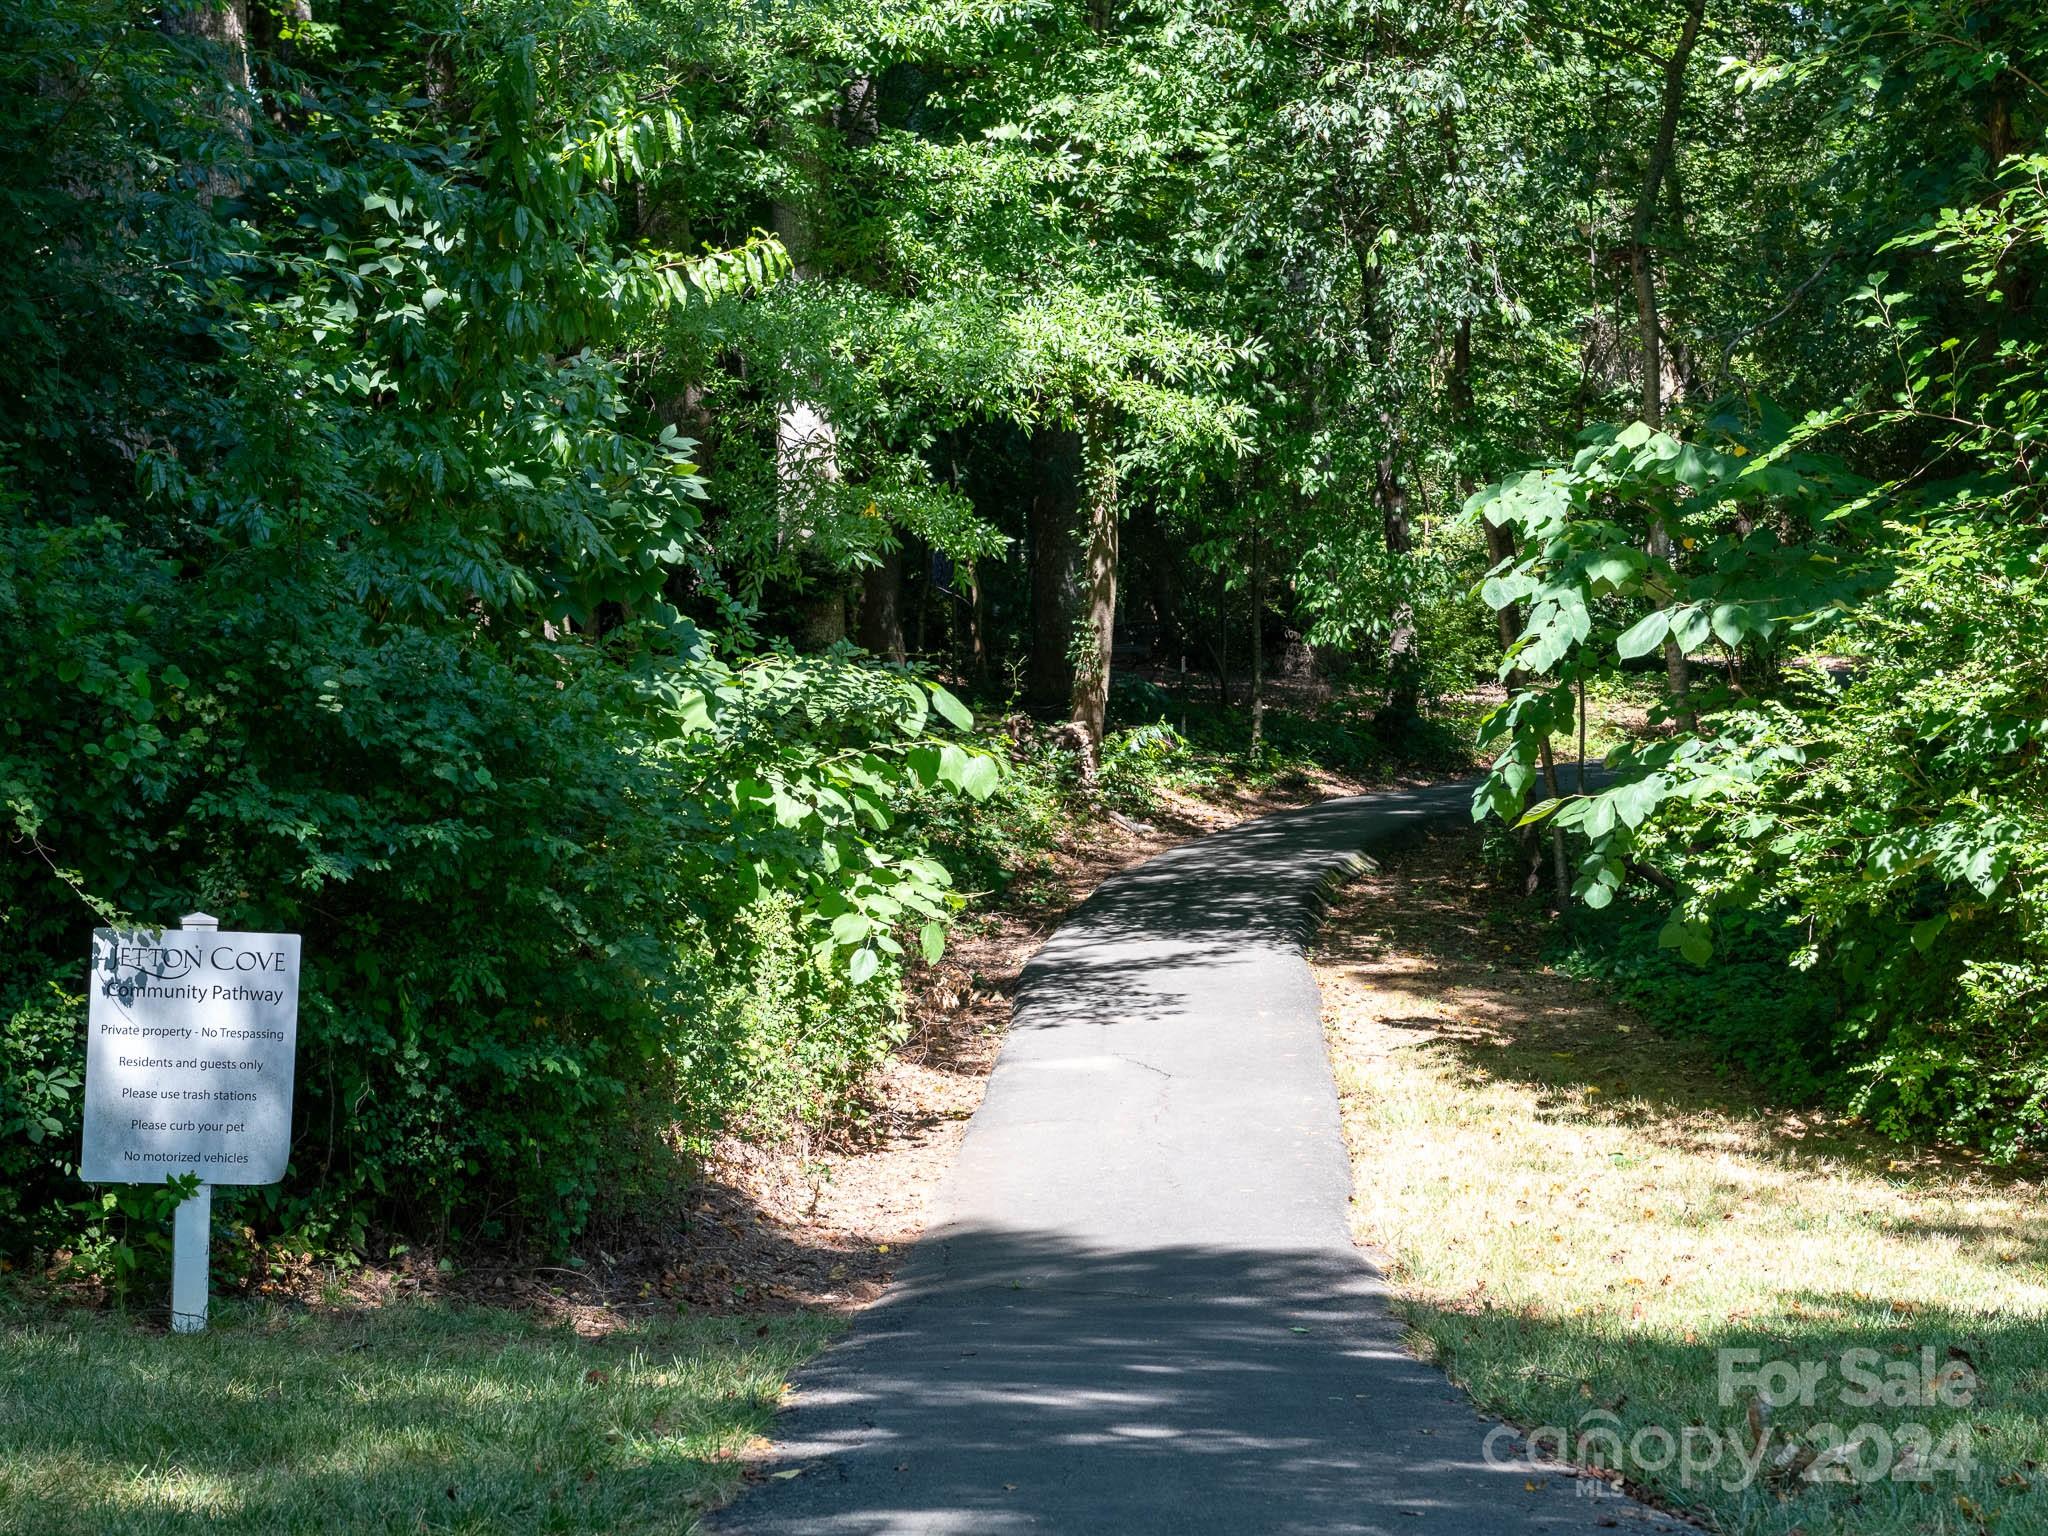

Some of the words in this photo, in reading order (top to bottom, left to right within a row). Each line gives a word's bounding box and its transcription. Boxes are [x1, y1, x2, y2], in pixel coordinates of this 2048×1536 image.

[210, 946, 286, 971] COVE
[106, 982, 207, 1003] Community
[212, 985, 284, 1005] Pathway
[101, 1024, 140, 1036] Private
[142, 1027, 192, 1039] property
[201, 1027, 218, 1038] No
[219, 1027, 284, 1042] Trespassing
[119, 1056, 173, 1068] Residents
[175, 1058, 197, 1069] and
[200, 1059, 237, 1071] guests
[239, 1059, 264, 1073] only
[122, 1087, 158, 1099] Please
[160, 1090, 180, 1100] use
[182, 1089, 210, 1101] trash
[213, 1090, 257, 1102] stations
[131, 1119, 167, 1131] Please
[169, 1120, 195, 1131] curb
[198, 1123, 223, 1134] your
[226, 1122, 245, 1134] pet
[124, 1151, 140, 1162] No
[143, 1151, 201, 1163] motorized
[204, 1152, 249, 1164] vehicles
